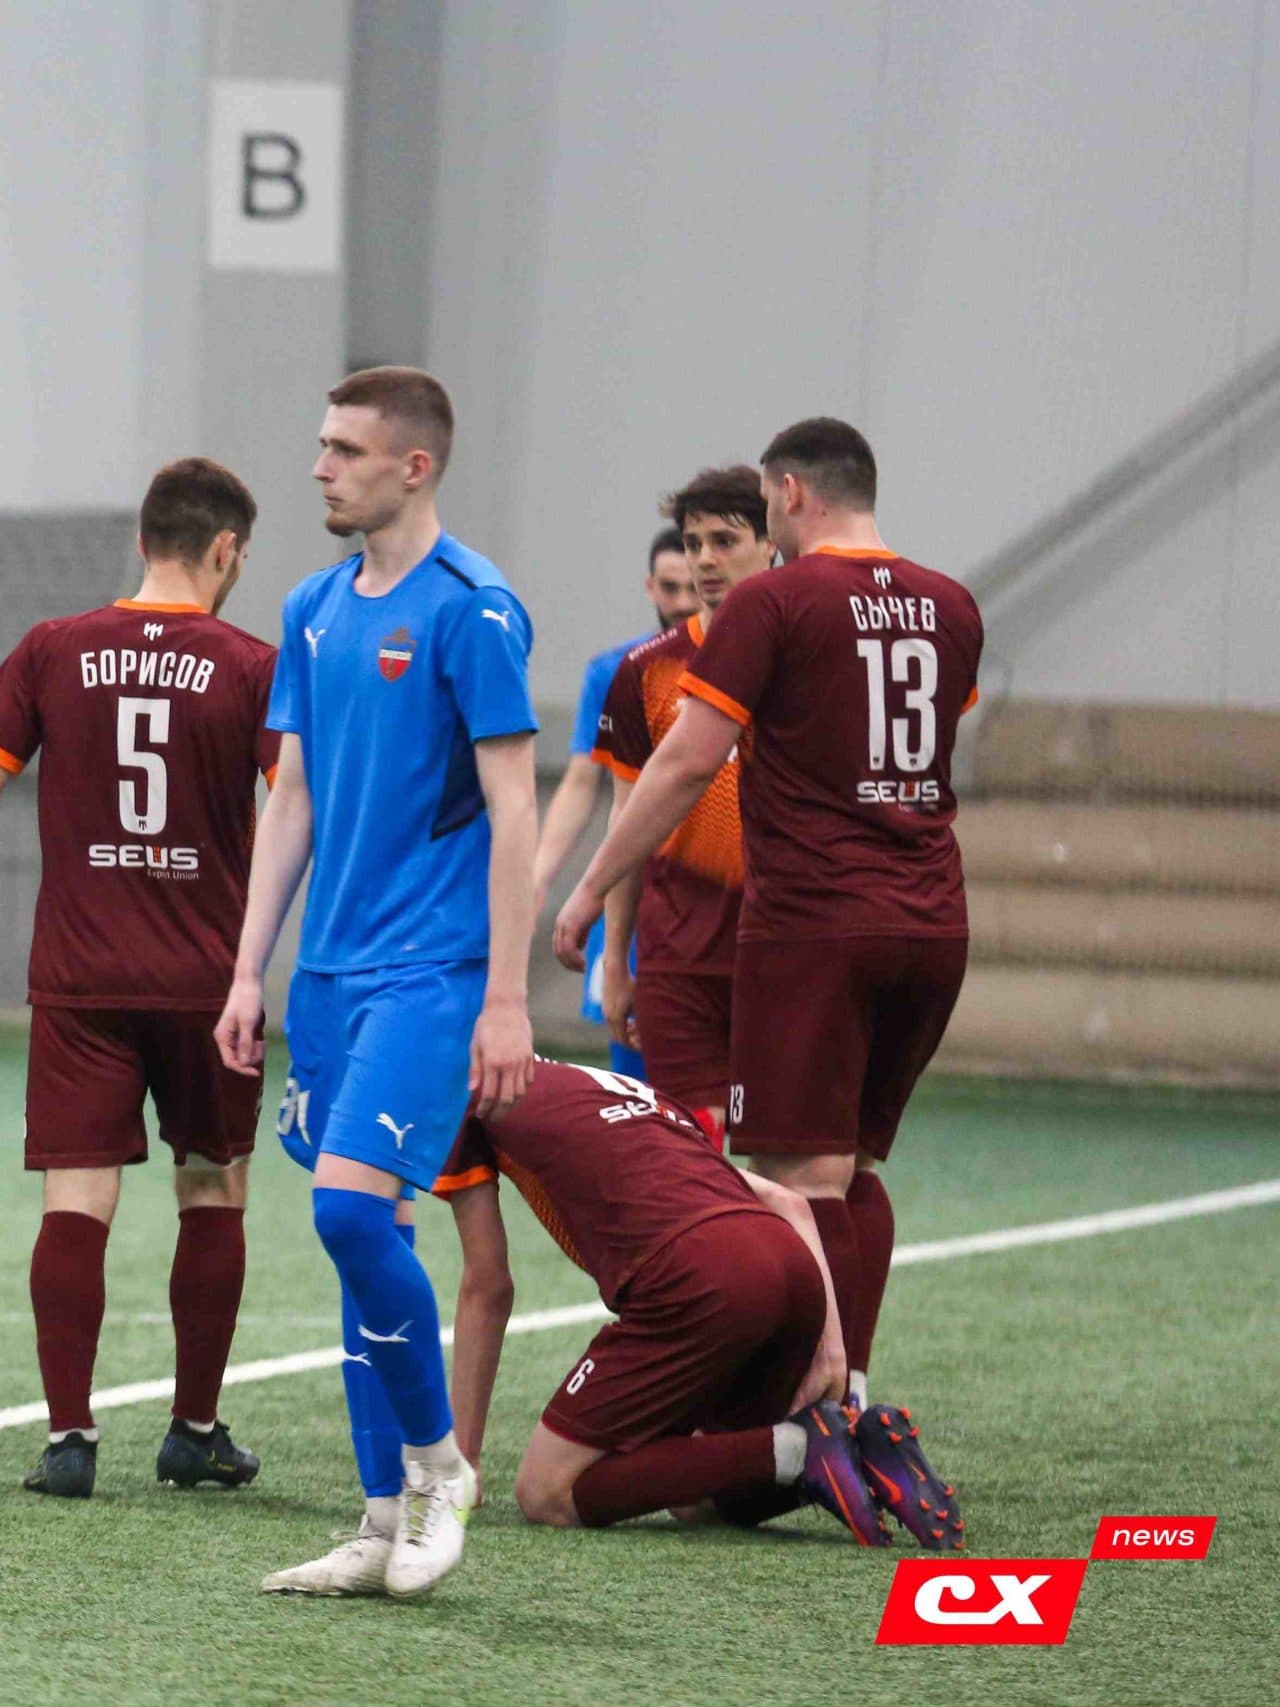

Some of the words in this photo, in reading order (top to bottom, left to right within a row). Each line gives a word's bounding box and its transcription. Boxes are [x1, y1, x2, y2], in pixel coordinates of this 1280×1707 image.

[240, 132, 306, 220] B
[848, 594, 936, 632] СЫЧЕВ
[80, 648, 216, 694] БОРИСОВ
[856, 638, 938, 772] 13
[117, 695, 171, 836] 5
[856, 780, 940, 804] SEUS
[88, 844, 199, 871] SEUS
[599, 1101, 694, 1124] SE
[729, 1083, 744, 1125] 13
[566, 1357, 596, 1395] 6
